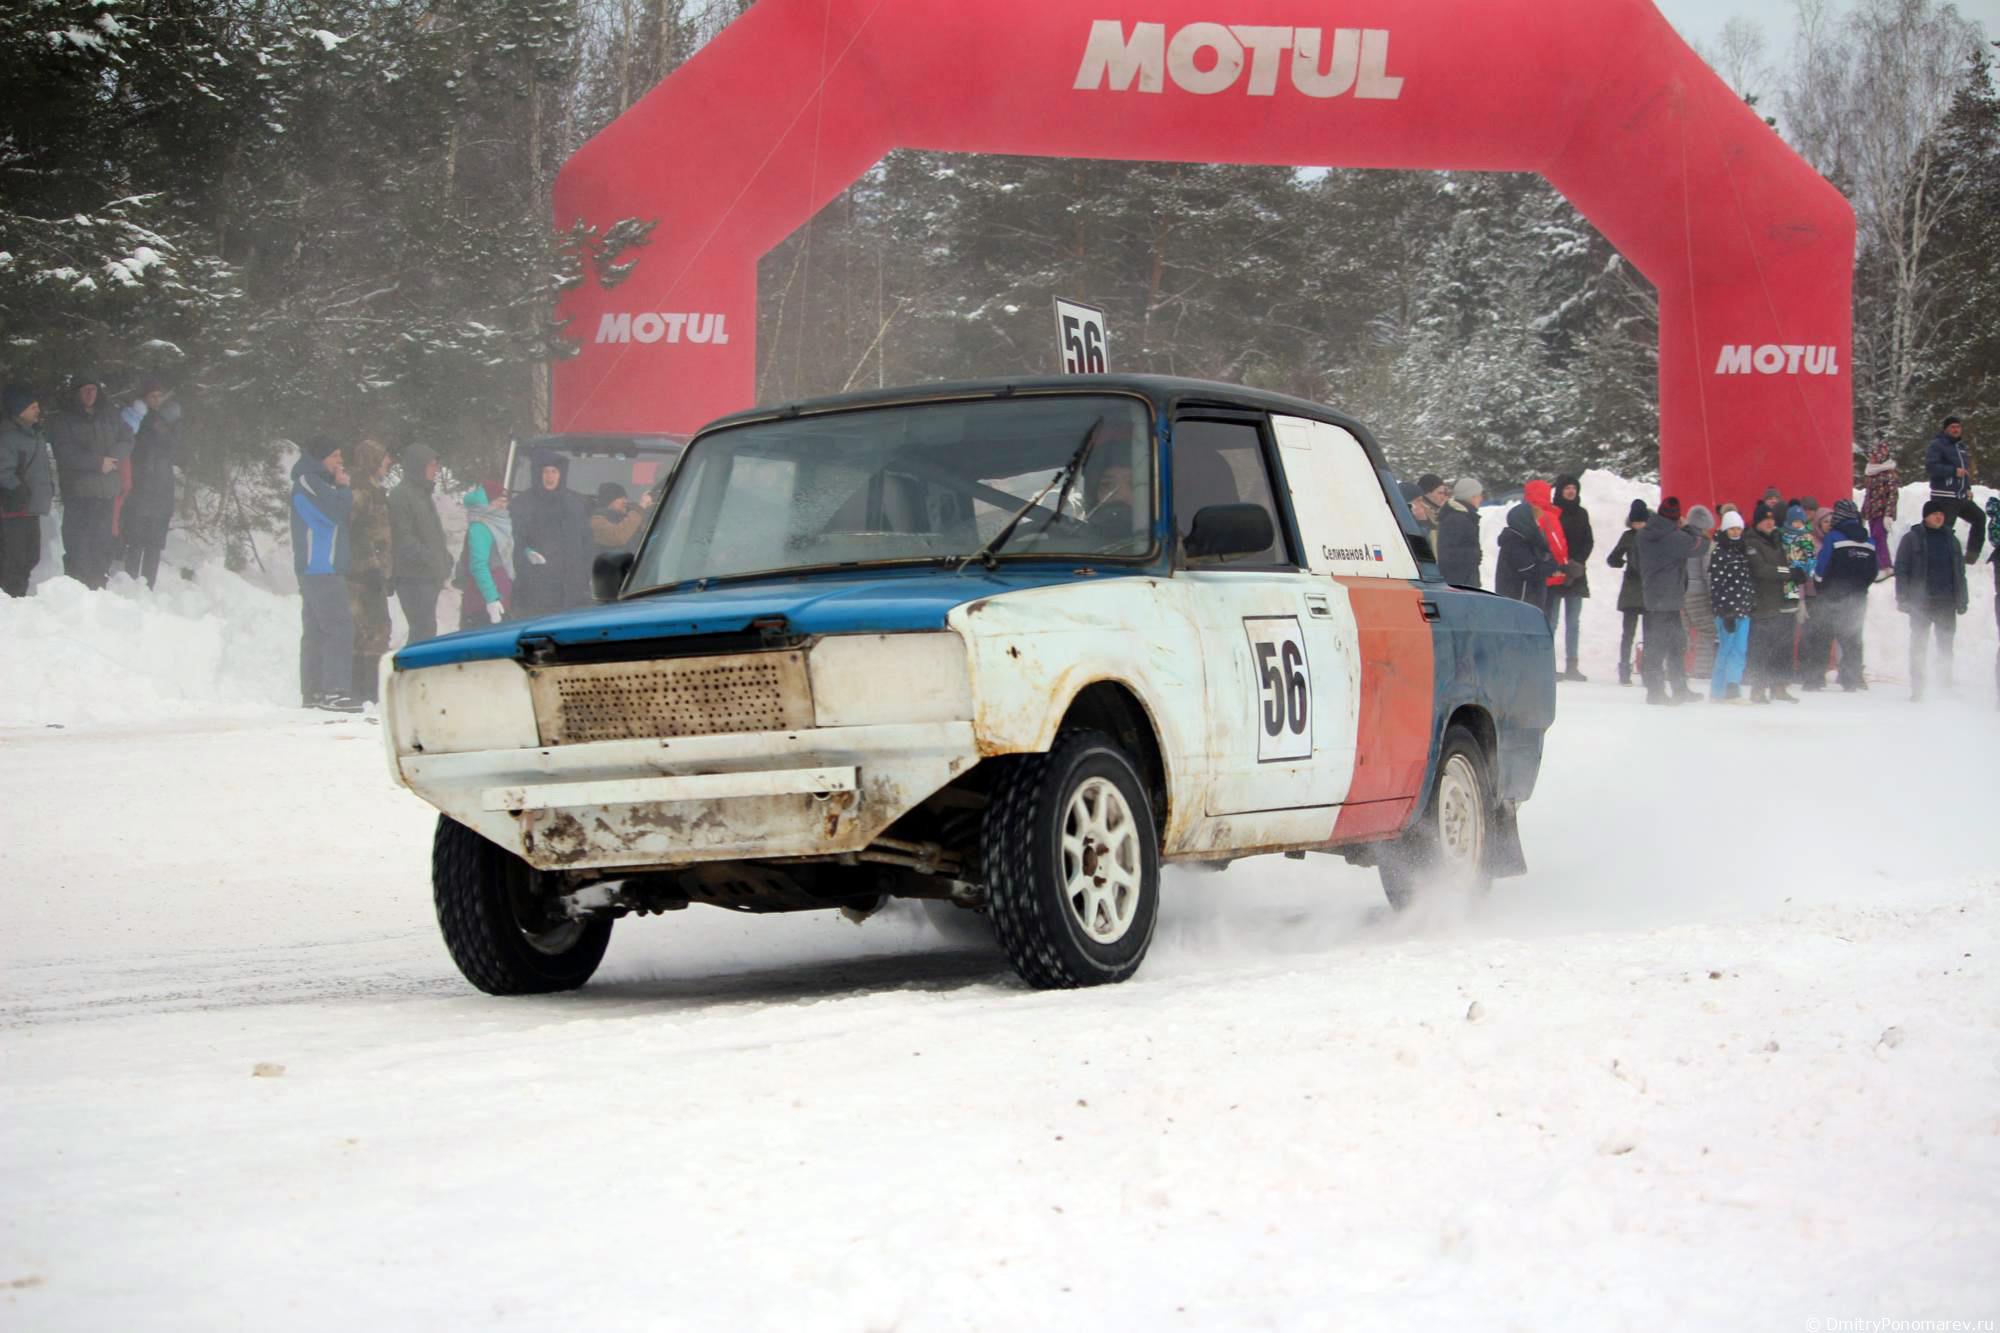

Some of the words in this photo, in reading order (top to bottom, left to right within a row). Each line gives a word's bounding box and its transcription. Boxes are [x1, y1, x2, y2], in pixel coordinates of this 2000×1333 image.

[1072, 20, 1405, 99] MOTUL
[594, 312, 729, 344] MOTUL
[1063, 315, 1104, 374] 56
[1715, 344, 1839, 375] MOTUL
[1322, 545, 1364, 560] Селиванов
[1255, 640, 1307, 736] 56
